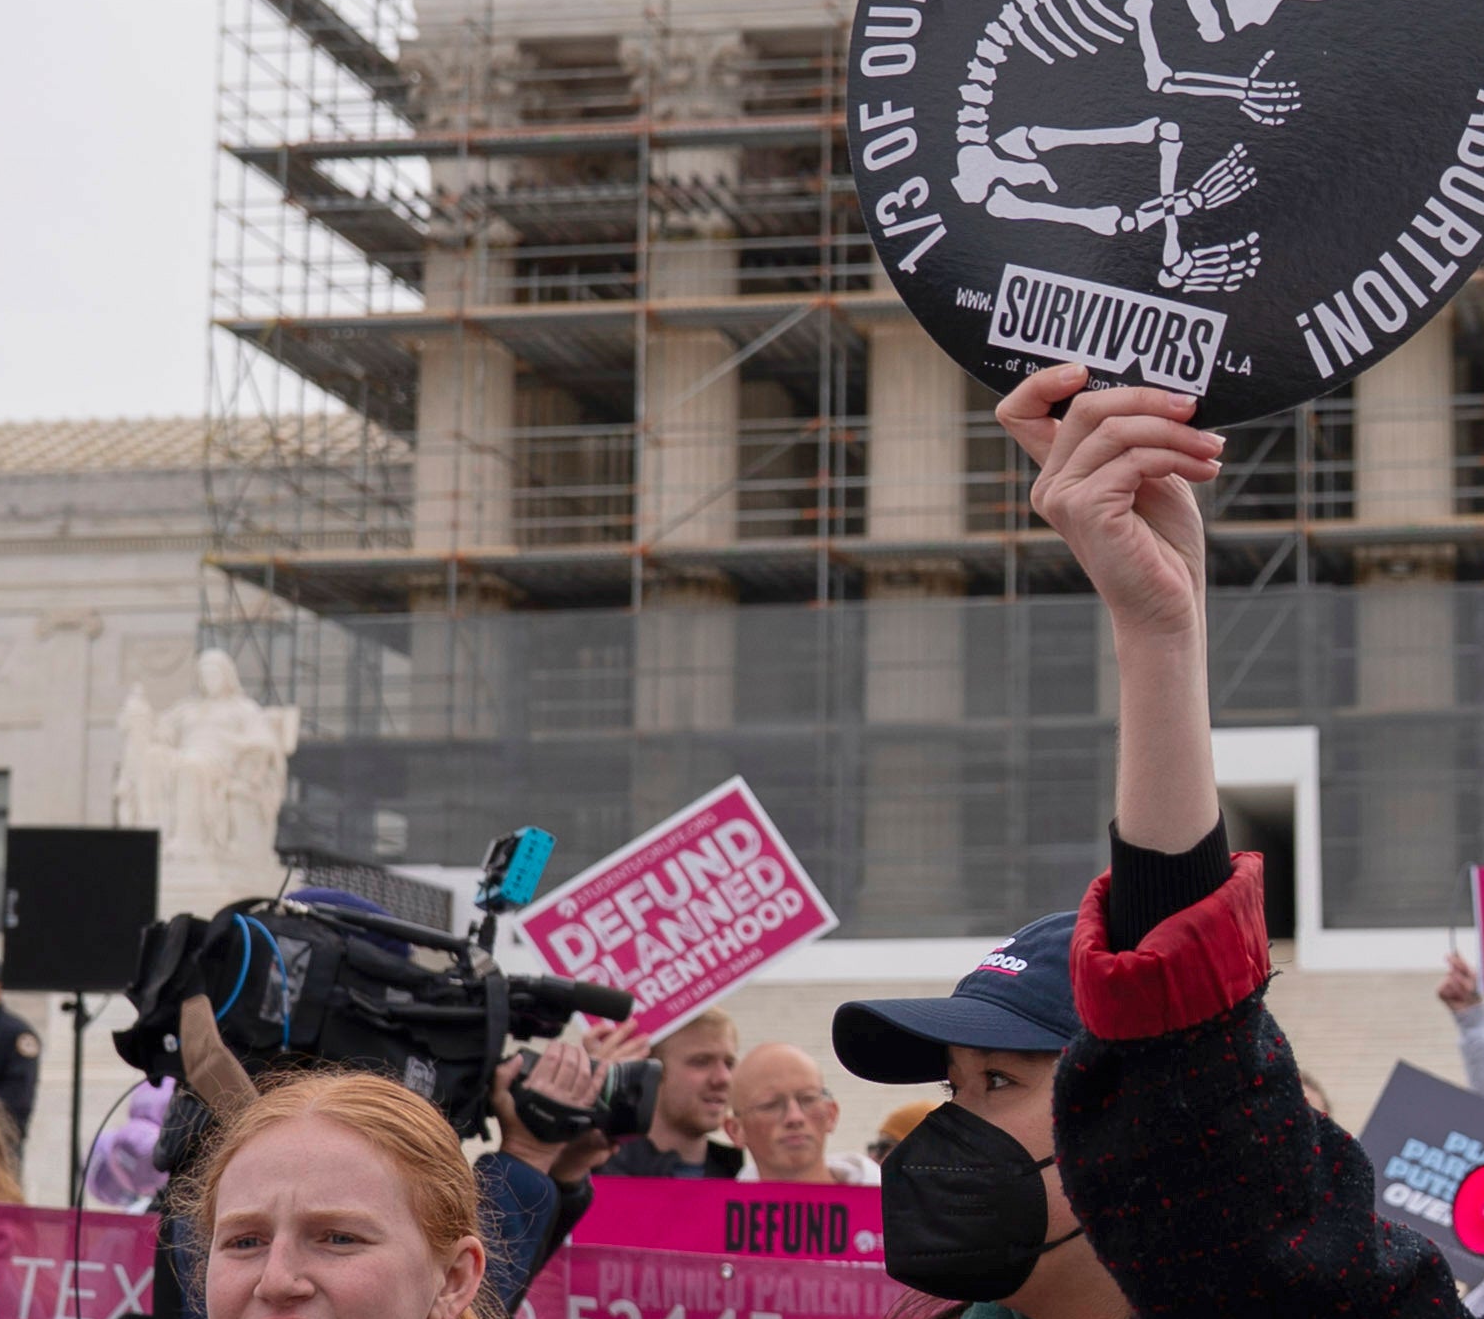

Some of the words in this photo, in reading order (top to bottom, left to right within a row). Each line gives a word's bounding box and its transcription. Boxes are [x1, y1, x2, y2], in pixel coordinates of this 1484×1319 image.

[859, 100, 918, 172] OF
[878, 178, 948, 275] 1/3
[998, 275, 1214, 383] SURVIVORS
[547, 819, 762, 973] DEFUND
[621, 887, 804, 1016] ARENTHOOD
[724, 1200, 850, 1255] DEFUND
